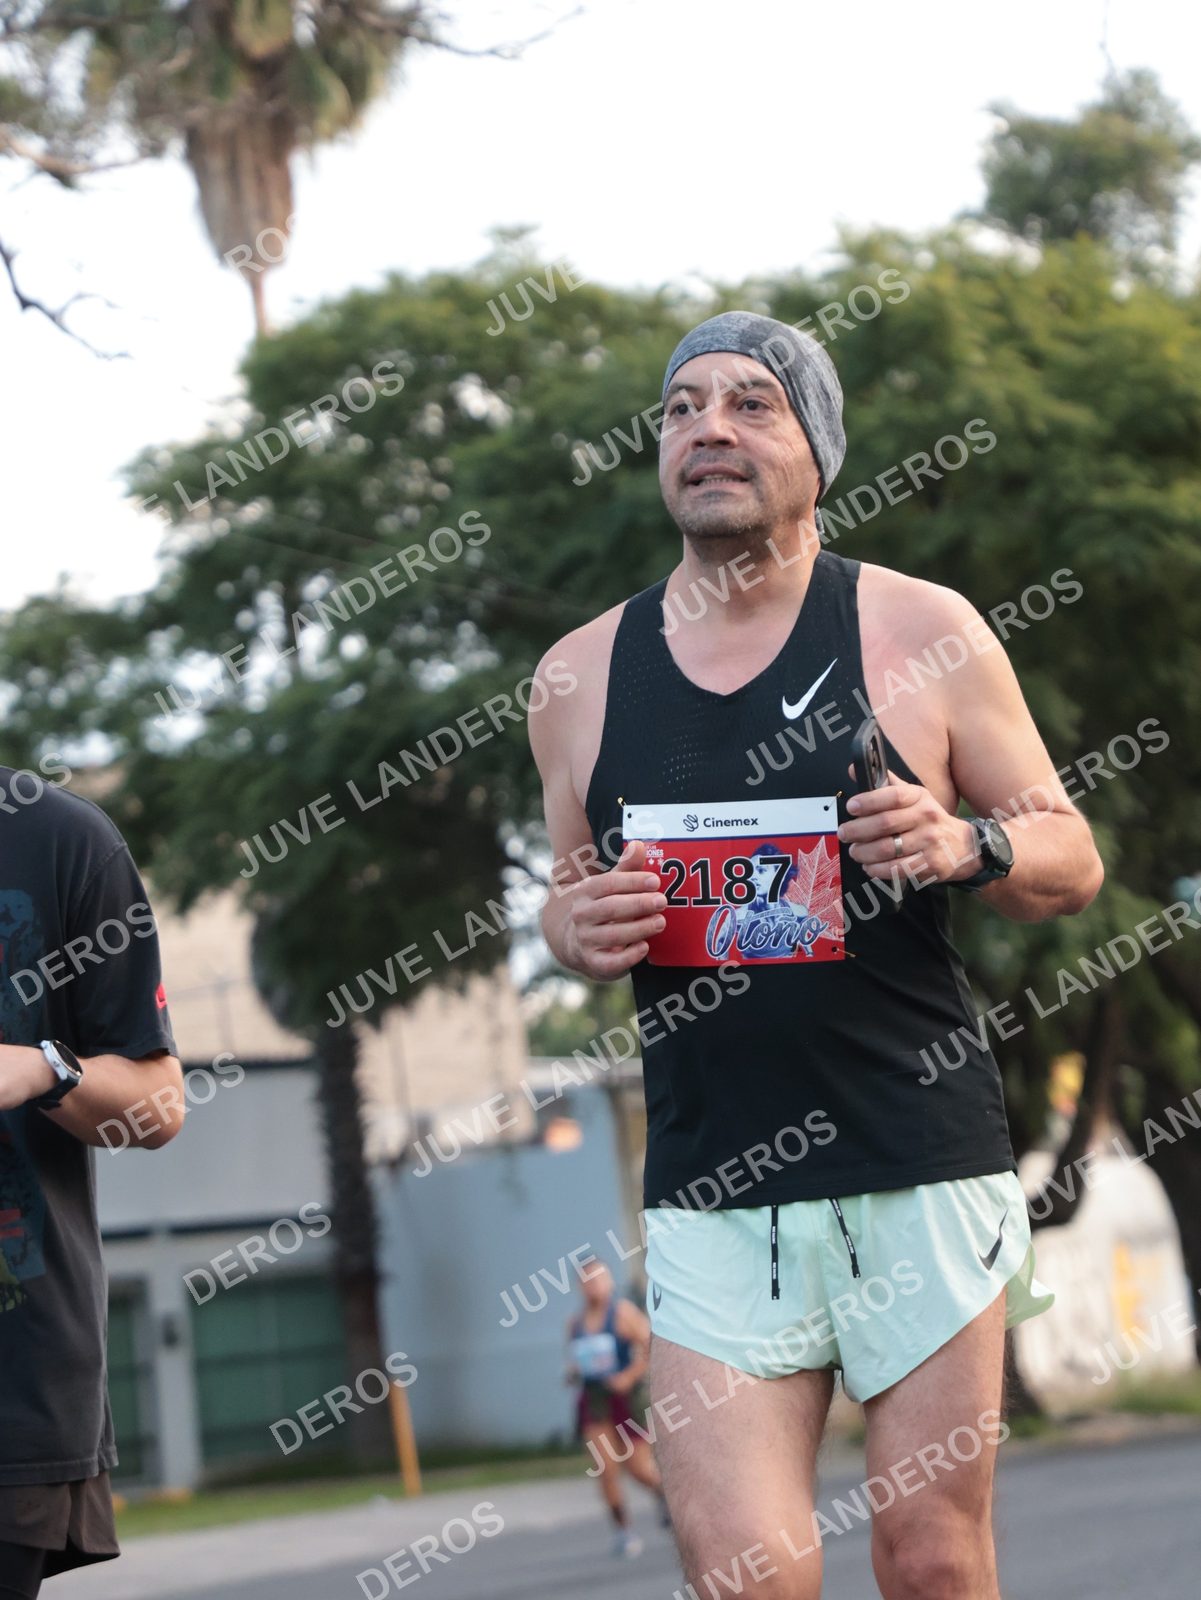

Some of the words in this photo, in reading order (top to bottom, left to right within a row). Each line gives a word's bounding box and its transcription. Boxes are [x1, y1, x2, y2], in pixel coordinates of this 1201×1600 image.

[702, 817, 759, 828] Cinemex
[660, 855, 793, 908] 2187
[705, 904, 829, 959] Otoño
